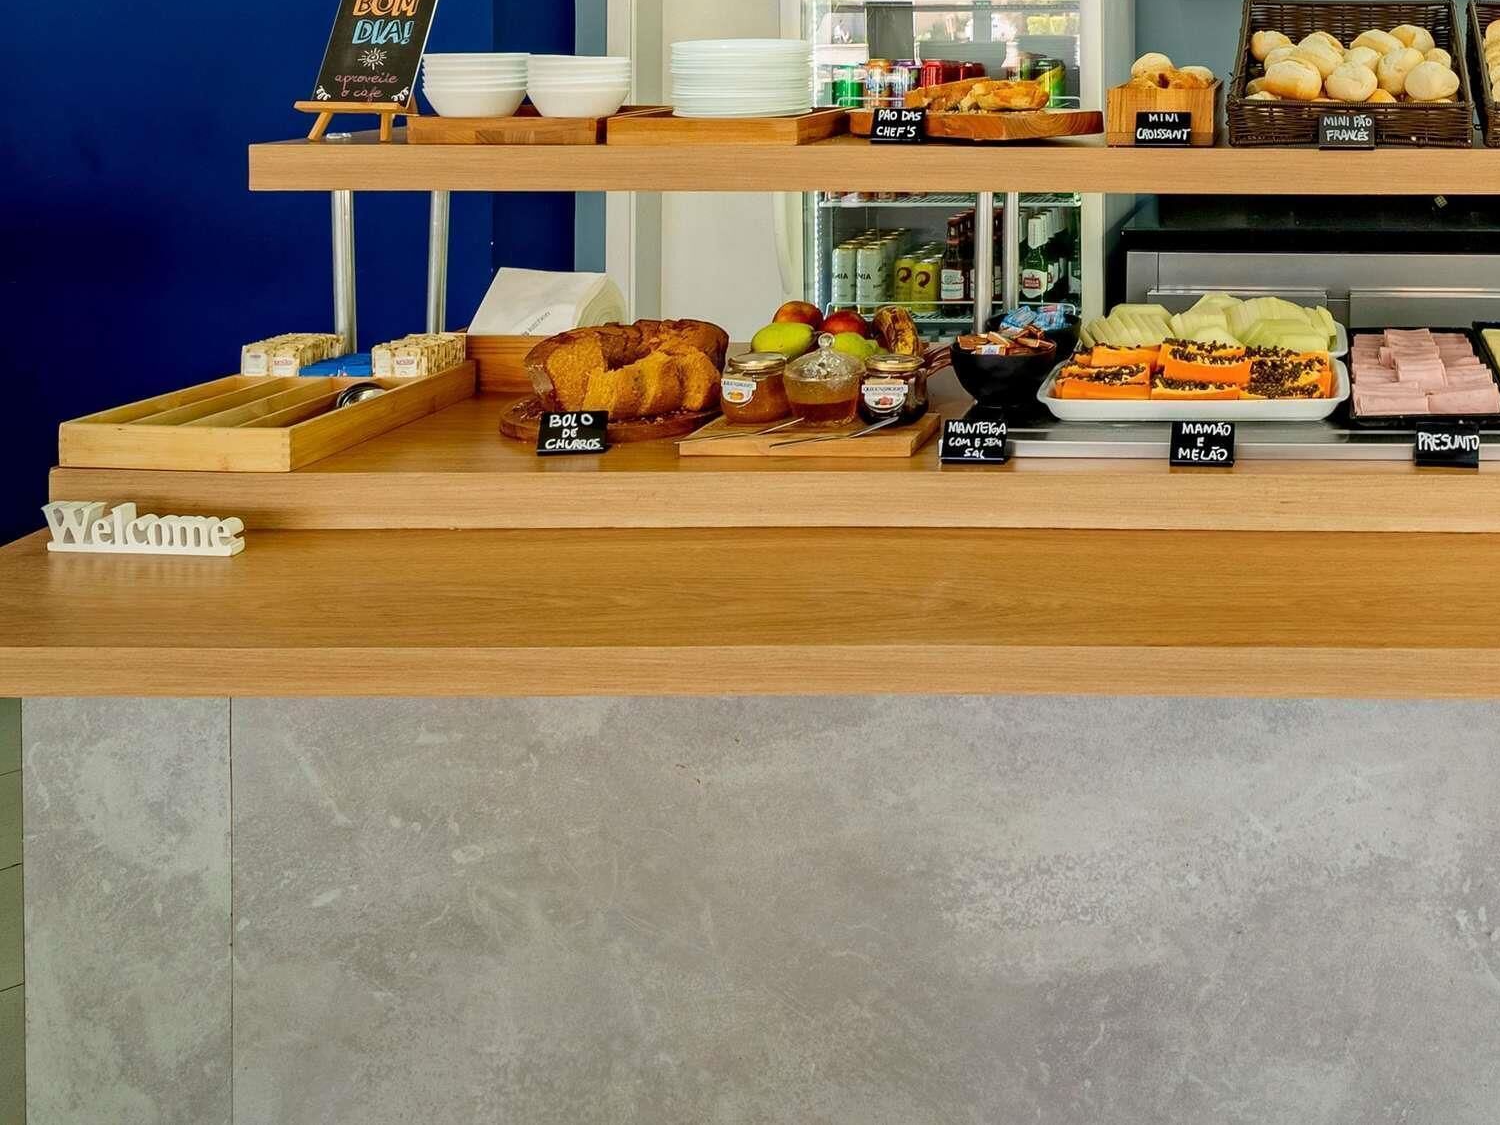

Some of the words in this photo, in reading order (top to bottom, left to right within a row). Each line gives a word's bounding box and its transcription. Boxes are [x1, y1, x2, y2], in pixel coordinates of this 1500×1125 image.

[352, 19, 414, 45] DIA!
[334, 73, 400, 90] aproveite
[902, 110, 922, 121] DAS
[1148, 113, 1179, 122] MINI
[1323, 115, 1350, 126] MINI
[1353, 114, 1373, 127] PÃO
[876, 125, 917, 137] CHEF'S
[1136, 127, 1191, 140] CROISSANT
[549, 413, 594, 427] BOLO
[562, 427, 579, 438] DE
[948, 421, 1007, 436] MANTEIGA
[1181, 422, 1231, 436] MAMÃO
[545, 438, 601, 450] CHURROS
[948, 437, 971, 446] COM
[982, 437, 1002, 447] SEM
[1196, 436, 1205, 447] E
[1417, 431, 1480, 451] PRESUNTO
[963, 448, 985, 459] SAL
[1178, 446, 1228, 461] MELÃO
[41, 501, 245, 548] Welcome
